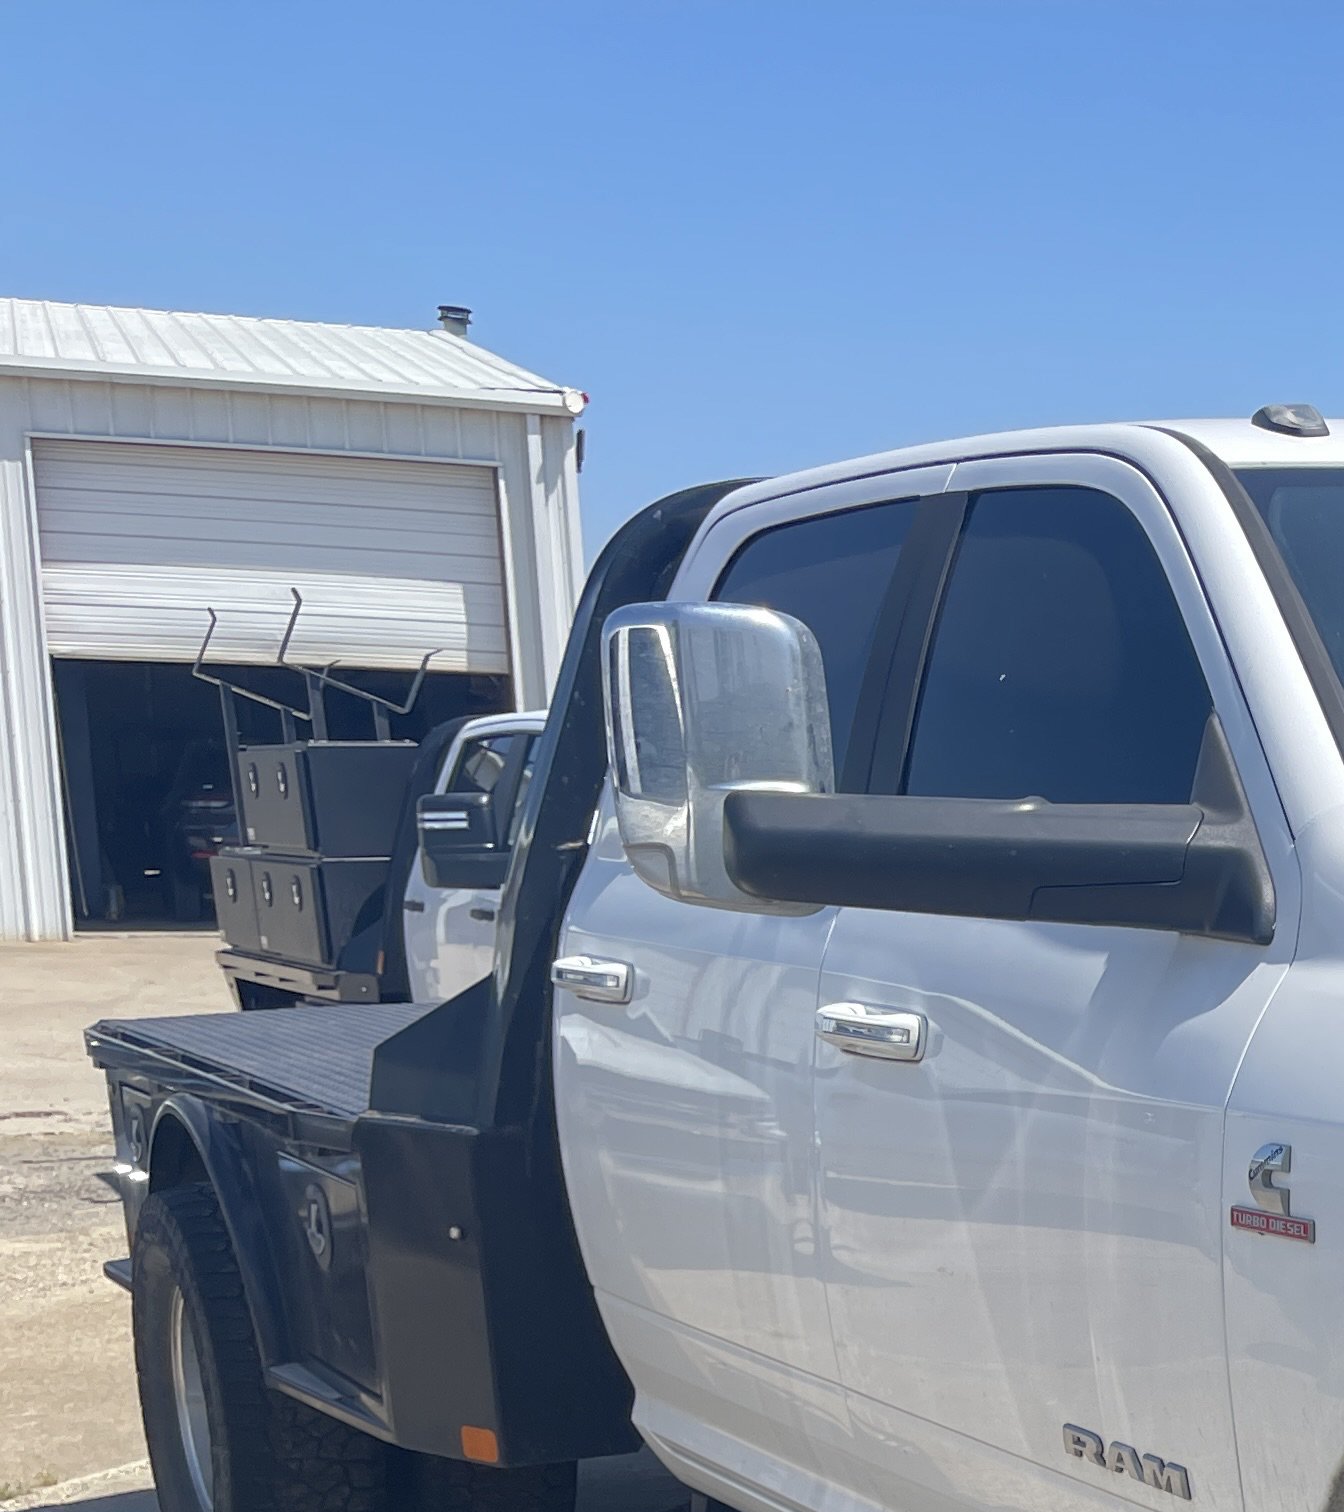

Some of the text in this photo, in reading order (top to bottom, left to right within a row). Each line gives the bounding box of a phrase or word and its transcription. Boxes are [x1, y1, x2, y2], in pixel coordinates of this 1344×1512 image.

[1232, 1210, 1307, 1237] TURBO DIESEL
[1062, 1422, 1192, 1501] RAM
